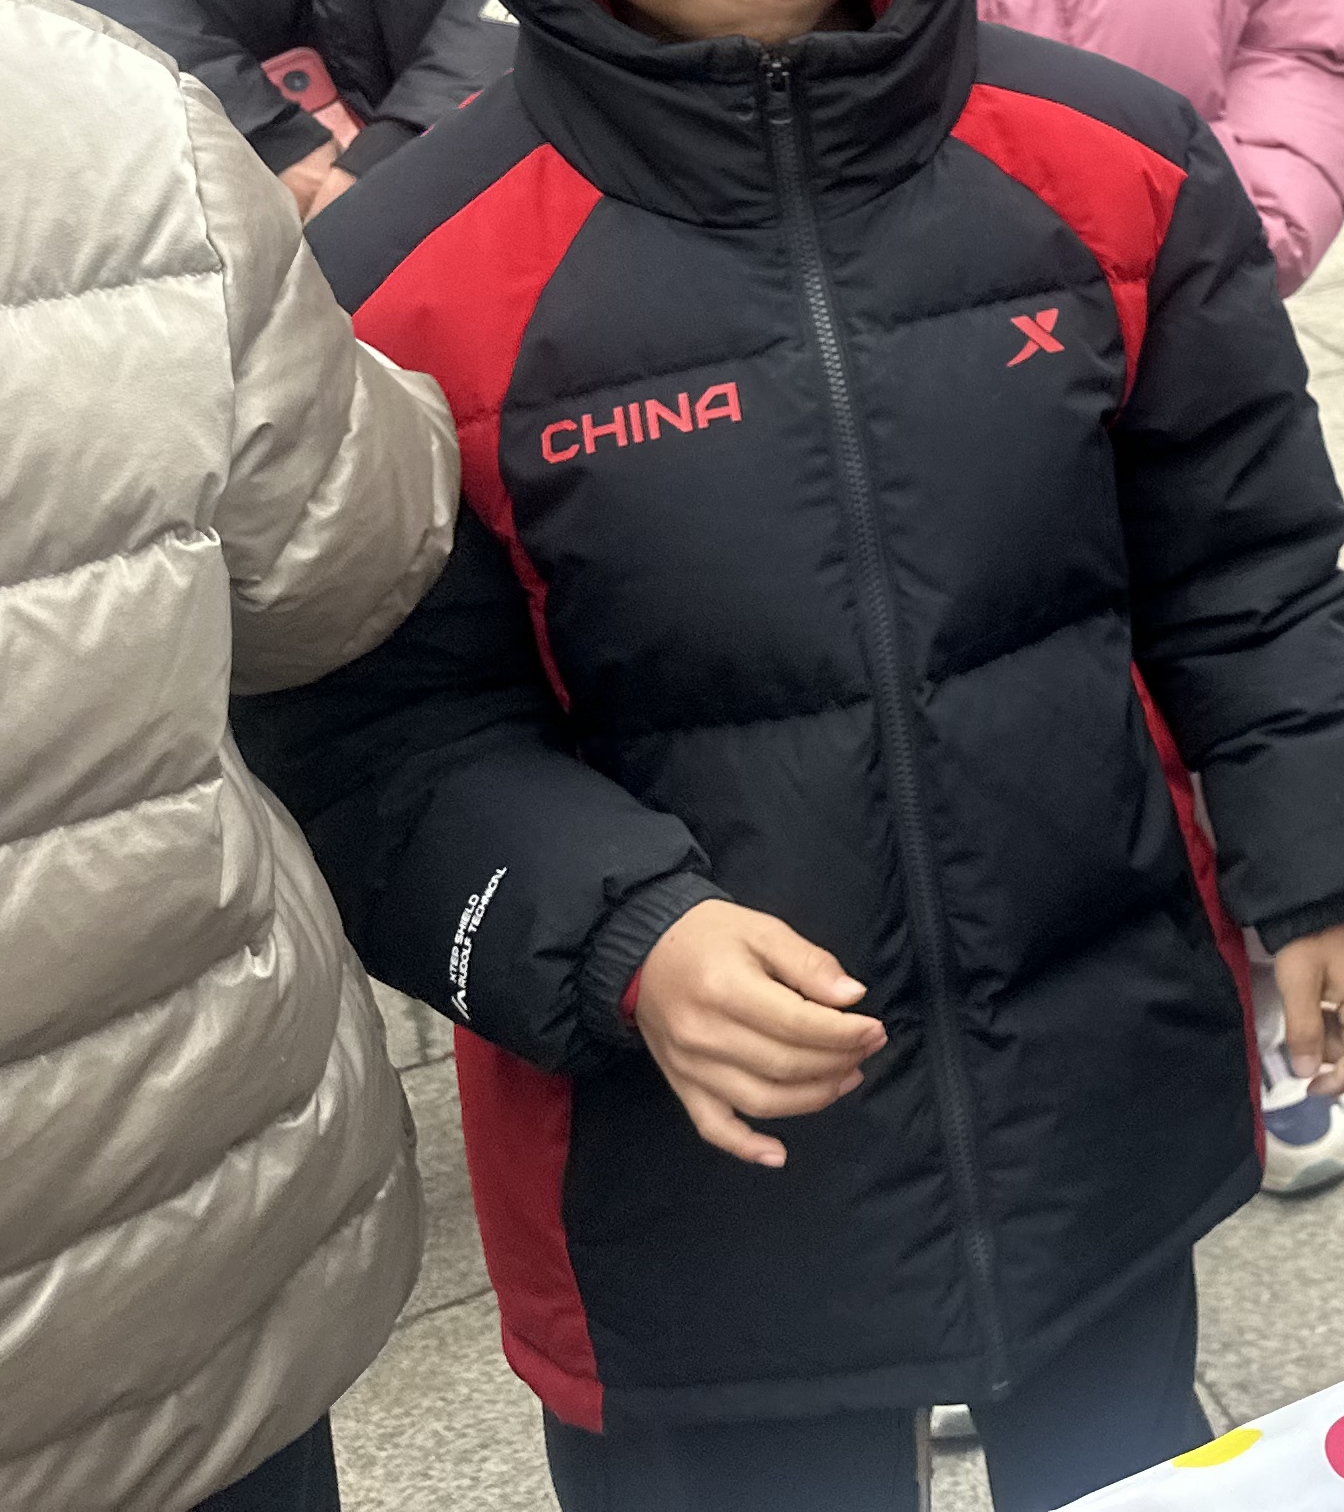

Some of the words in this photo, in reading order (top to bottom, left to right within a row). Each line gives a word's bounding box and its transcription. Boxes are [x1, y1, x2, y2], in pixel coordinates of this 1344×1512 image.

[541, 382, 742, 464] CHINA
[454, 893, 480, 945] SHIELD
[457, 936, 472, 989] RUDOLF
[468, 866, 508, 933] TECHNICAL
[449, 945, 460, 984] XTEP
